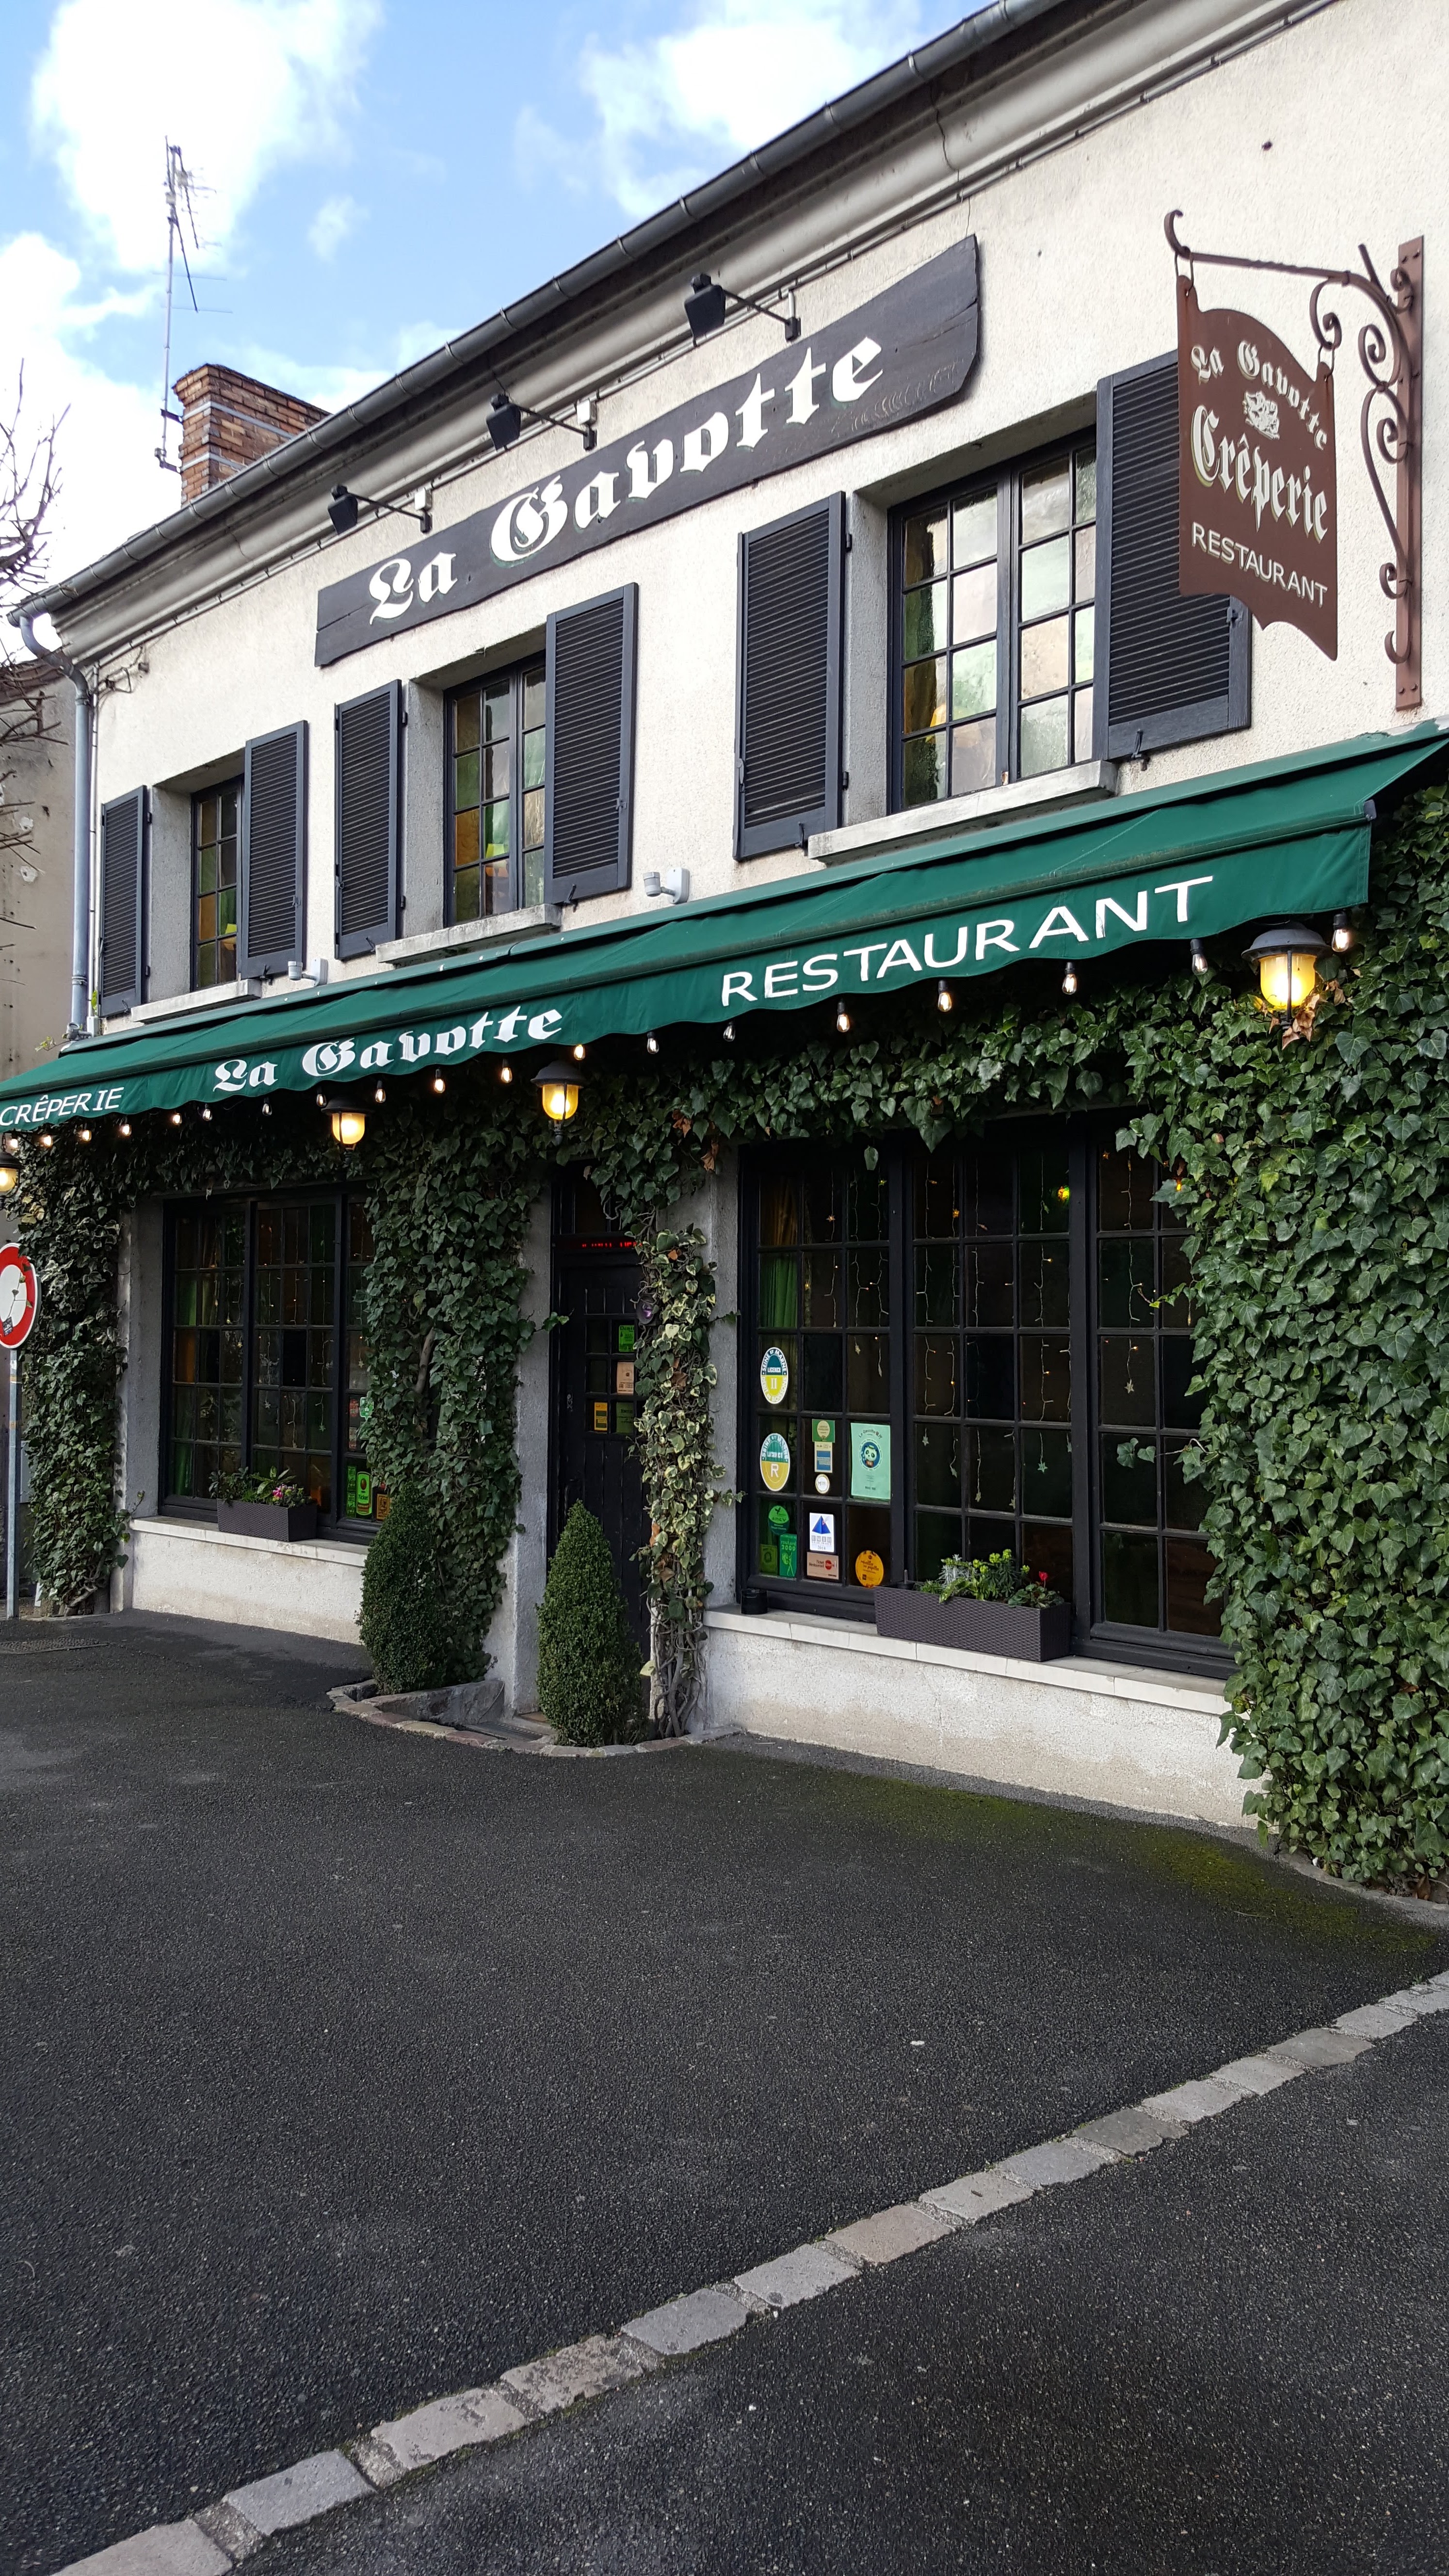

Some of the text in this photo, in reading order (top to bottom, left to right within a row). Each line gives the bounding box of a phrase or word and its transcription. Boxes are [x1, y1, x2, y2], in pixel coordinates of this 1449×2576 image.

[1191, 340, 1327, 451] La Gavotte
[361, 336, 884, 625] La Gavotte
[1192, 404, 1328, 543] Crêperie
[1192, 522, 1328, 606] RESTAURANT
[722, 876, 1213, 1006] RESTAURANT
[213, 1006, 562, 1092] La Gavotte
[0, 1087, 124, 1127] CRÊPERIE
[774, 1350, 787, 1372] MARNE
[771, 1464, 779, 1478] R
